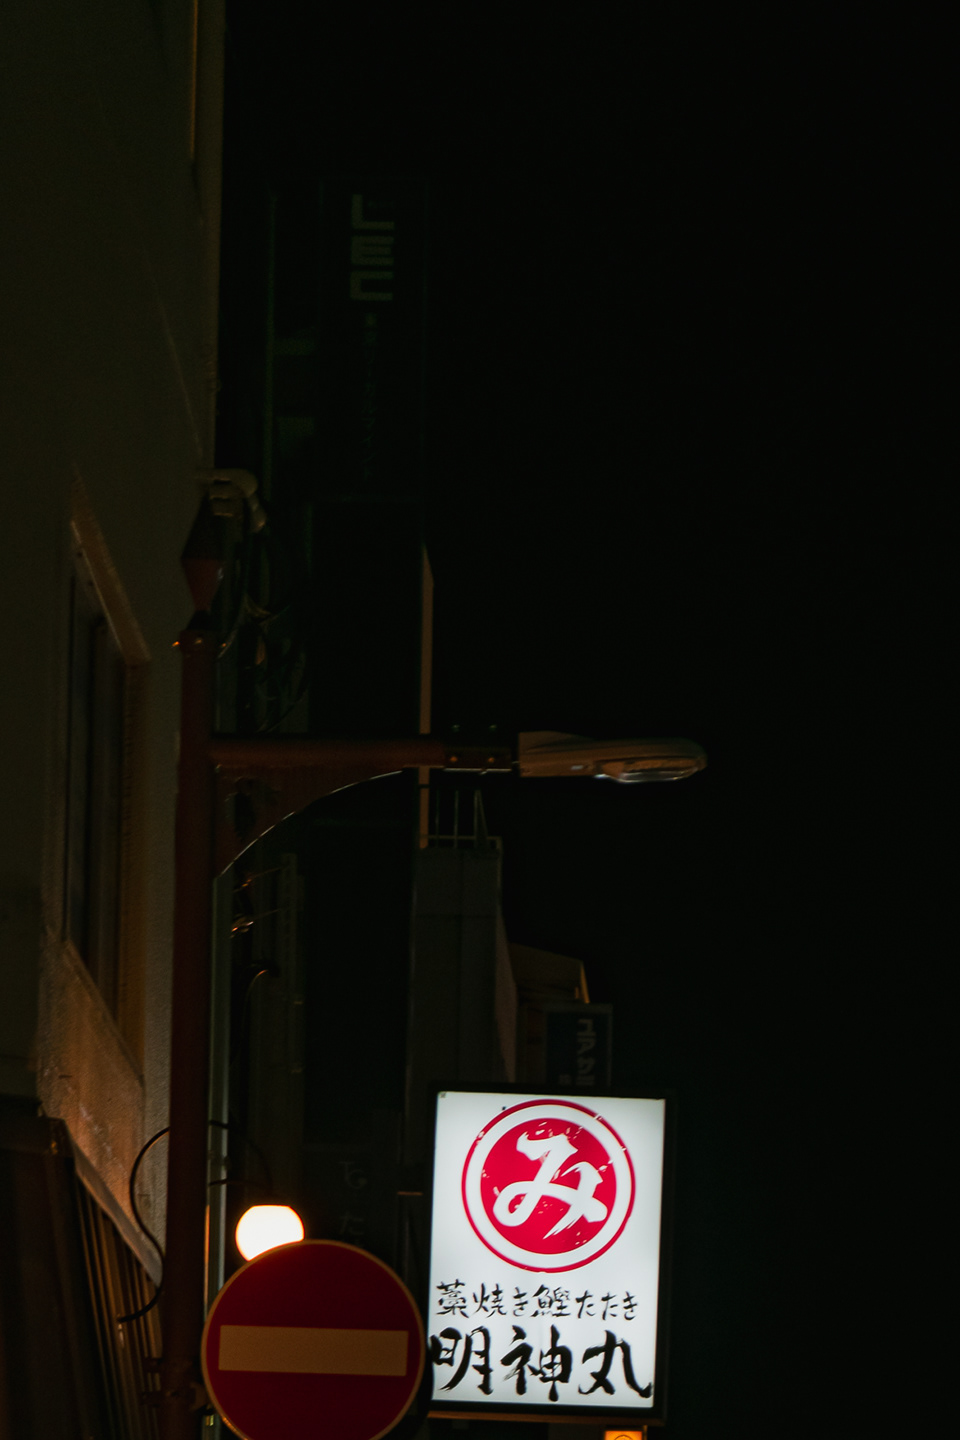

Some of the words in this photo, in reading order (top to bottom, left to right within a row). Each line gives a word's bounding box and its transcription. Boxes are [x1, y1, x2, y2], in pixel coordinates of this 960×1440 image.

[492, 1132, 609, 1240] み
[436, 1279, 639, 1321] 藁焼き鰹たたき
[429, 1324, 654, 1402] 明神丸
